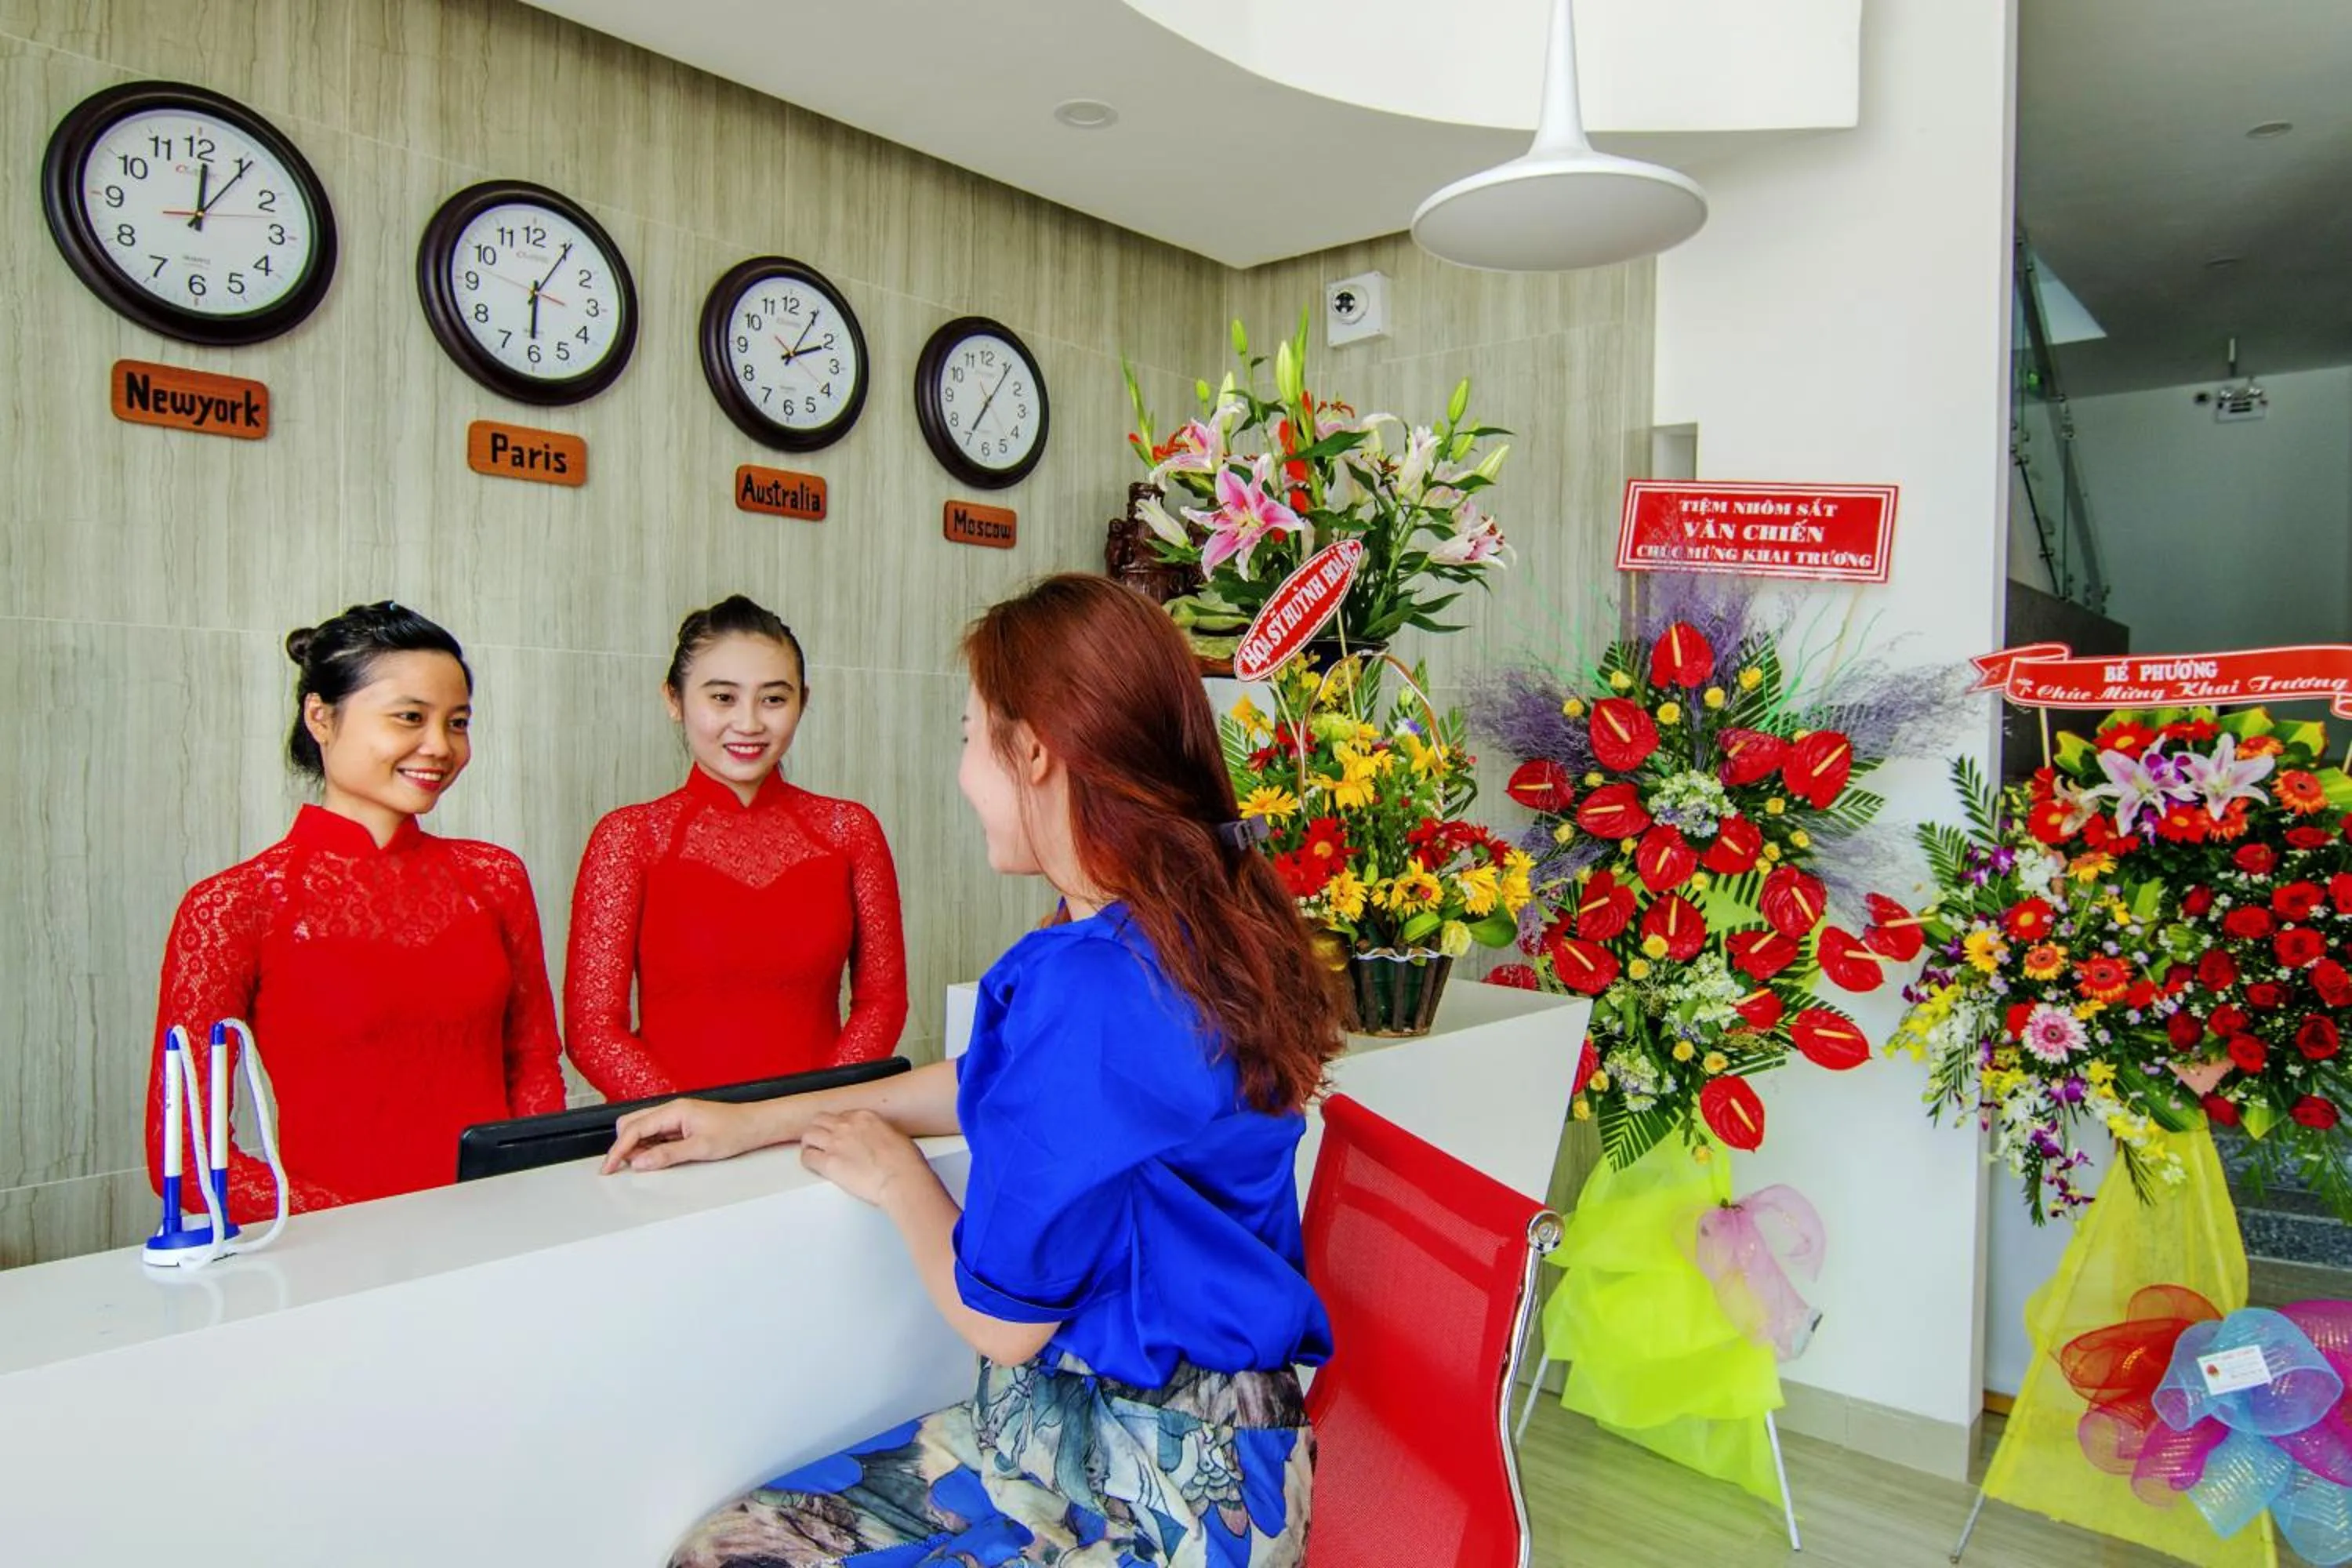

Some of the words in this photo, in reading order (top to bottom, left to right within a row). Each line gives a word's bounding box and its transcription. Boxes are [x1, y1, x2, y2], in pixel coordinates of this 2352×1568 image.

[149, 136, 172, 161] 11
[183, 135, 216, 162] 12
[118, 154, 148, 180] 10
[105, 185, 124, 208] 9
[258, 190, 276, 212] 2
[117, 223, 136, 247] 8
[268, 224, 285, 245] 3
[497, 227, 514, 248] 11
[522, 226, 546, 248] 12
[474, 244, 497, 266] 10
[149, 255, 169, 278] 7
[253, 255, 274, 276] 4
[188, 274, 207, 296] 6
[227, 272, 245, 294] 5
[466, 270, 479, 291] 9
[579, 269, 592, 289] 2
[474, 303, 488, 323] 8
[586, 298, 600, 318] 3
[762, 298, 775, 315] 11
[782, 296, 800, 315] 12
[746, 314, 762, 331] 10
[498, 329, 512, 349] 7
[575, 325, 590, 344] 4
[823, 333, 835, 350] 2
[528, 344, 542, 363] 6
[556, 341, 570, 361] 5
[737, 336, 748, 354] 9
[829, 358, 840, 375] 3
[964, 353, 975, 368] 11
[980, 350, 995, 367] 12
[744, 364, 755, 382] 8
[951, 366, 964, 383] 10
[761, 387, 772, 404] 7
[820, 382, 831, 398] 4
[945, 387, 954, 402] 9
[1012, 381, 1022, 397] 2
[126, 371, 261, 427] Newyork
[783, 399, 795, 416] 6
[805, 396, 816, 413] 5
[949, 412, 959, 427] 8
[1017, 404, 1026, 419] 3
[964, 431, 973, 446] 7
[1011, 425, 1019, 439] 4
[491, 432, 567, 474] Paris
[981, 441, 990, 456] 6
[999, 438, 1007, 454] 5
[741, 473, 821, 511] Australia
[1679, 497, 1728, 516] TIỆM
[1733, 499, 1792, 515] NHÔM
[953, 509, 1011, 539] Moscow
[1682, 518, 1737, 540] VĂN
[1743, 519, 1825, 543] CHIẾN
[1742, 549, 1790, 563] KHAI
[2104, 659, 2130, 682] BÉ
[2172, 680, 2241, 697] Khai
